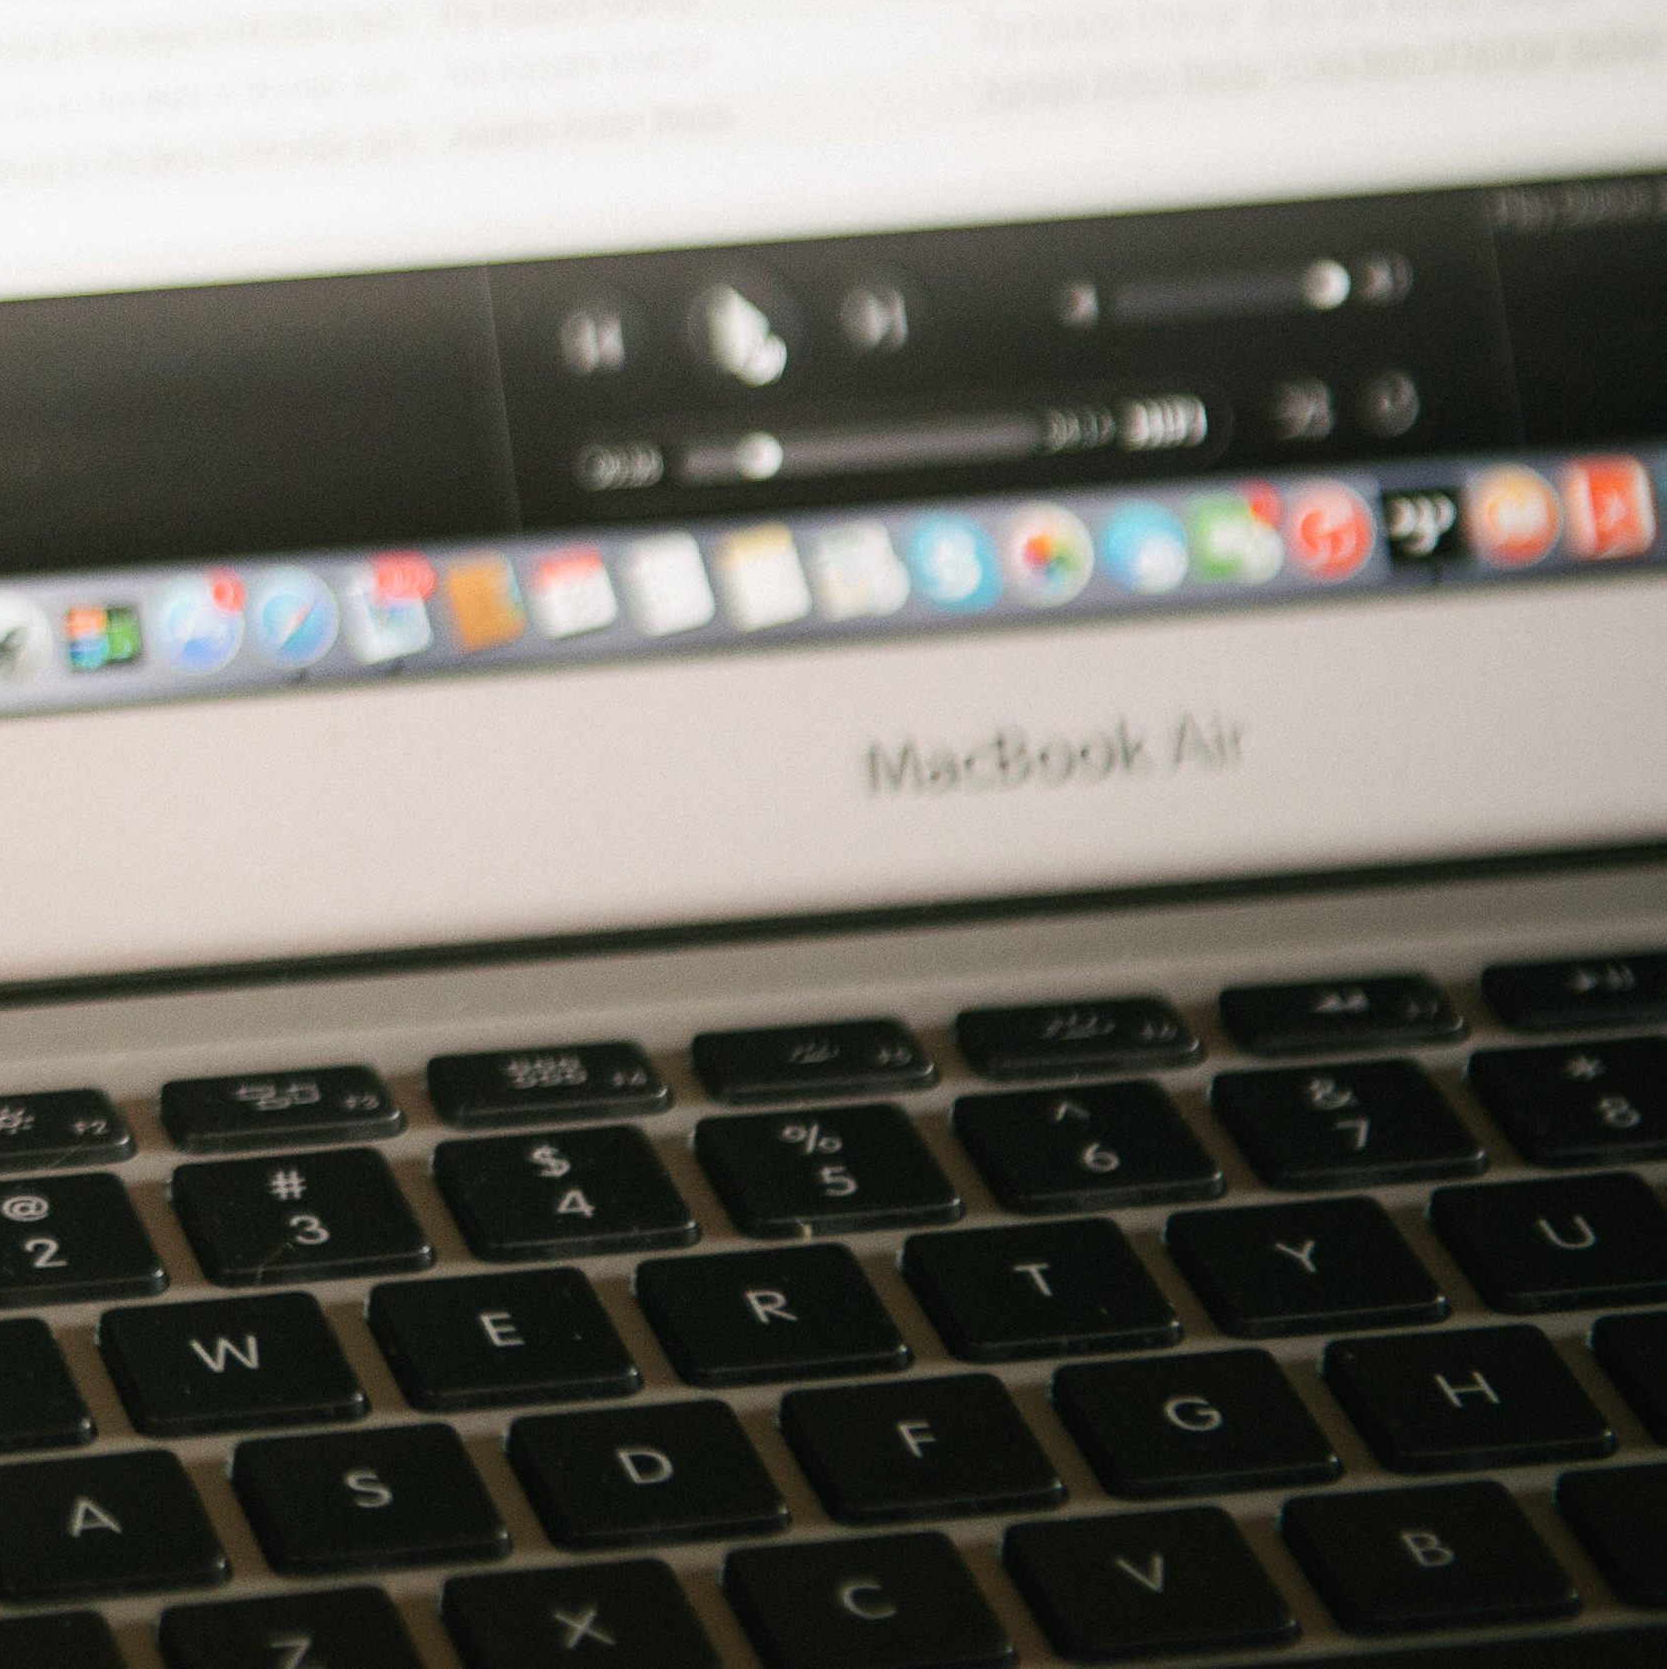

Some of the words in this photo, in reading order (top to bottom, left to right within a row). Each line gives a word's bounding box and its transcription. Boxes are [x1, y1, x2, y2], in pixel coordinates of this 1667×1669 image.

[865, 717, 1153, 796] MacBook
[1170, 712, 1247, 772] Air
[1598, 1097, 1641, 1128] 8
[780, 1123, 843, 1155] %
[1337, 1117, 1370, 1149] 7
[529, 1143, 571, 1178] $
[1081, 1142, 1120, 1172] 6
[270, 1169, 305, 1201] #
[818, 1165, 858, 1197] 5
[0, 1194, 50, 1223] @
[556, 1188, 595, 1218] 4
[288, 1213, 330, 1246] 3
[1537, 1214, 1597, 1250] U
[23, 1236, 66, 1269] 2
[1275, 1239, 1317, 1273] Y
[1013, 1262, 1052, 1297] T
[744, 1289, 797, 1324] R
[478, 1311, 523, 1348] E
[189, 1334, 260, 1373] W
[1434, 1370, 1500, 1408] H
[1162, 1395, 1223, 1432] G
[896, 1420, 934, 1458] F
[616, 1447, 674, 1485] D
[344, 1470, 393, 1509] S
[69, 1497, 122, 1537] A
[1400, 1530, 1455, 1568] B
[1115, 1553, 1165, 1593] V
[837, 1579, 896, 1620] C
[554, 1607, 613, 1649] X
